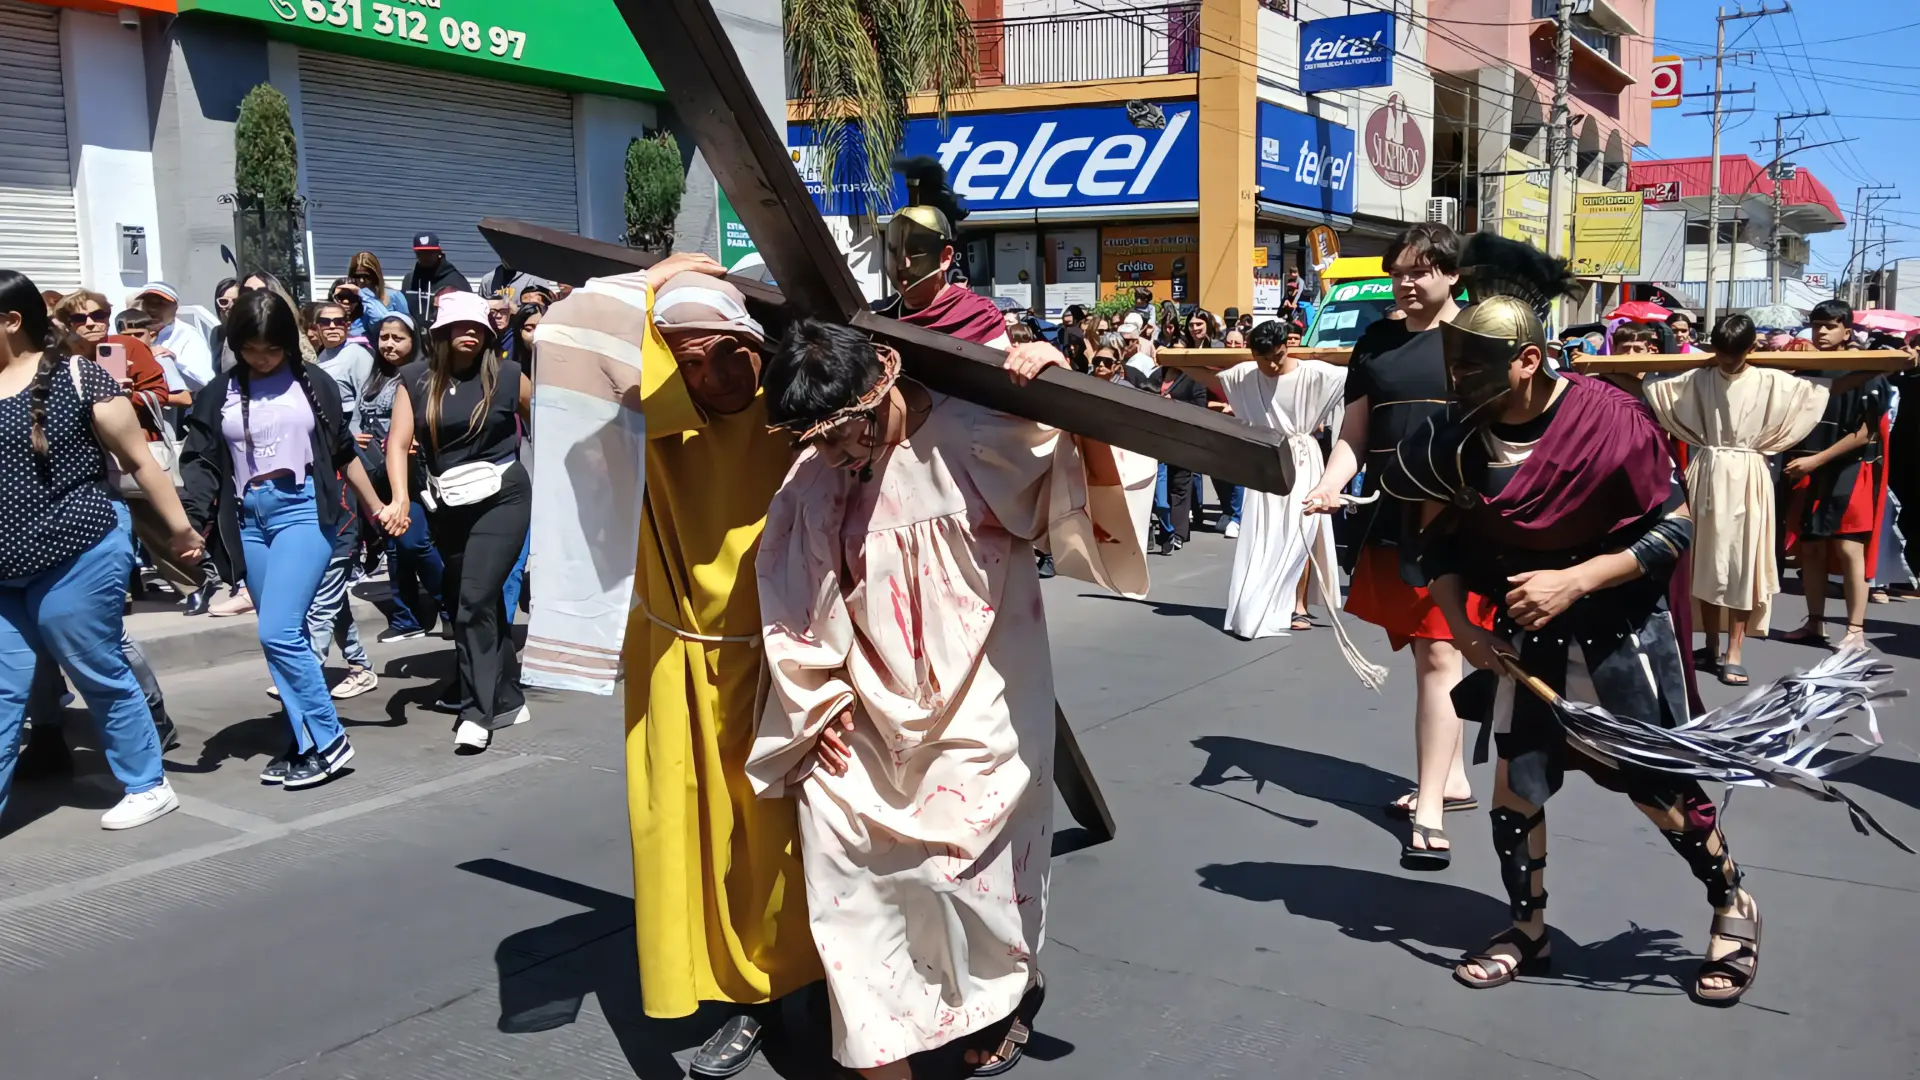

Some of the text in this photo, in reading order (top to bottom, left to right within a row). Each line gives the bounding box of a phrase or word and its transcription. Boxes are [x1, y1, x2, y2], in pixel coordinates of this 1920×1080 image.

[302, 0, 526, 59] 631 312 08 97
[1304, 30, 1383, 62] telcel
[936, 110, 1191, 200] telcel
[1295, 139, 1353, 191] telcel
